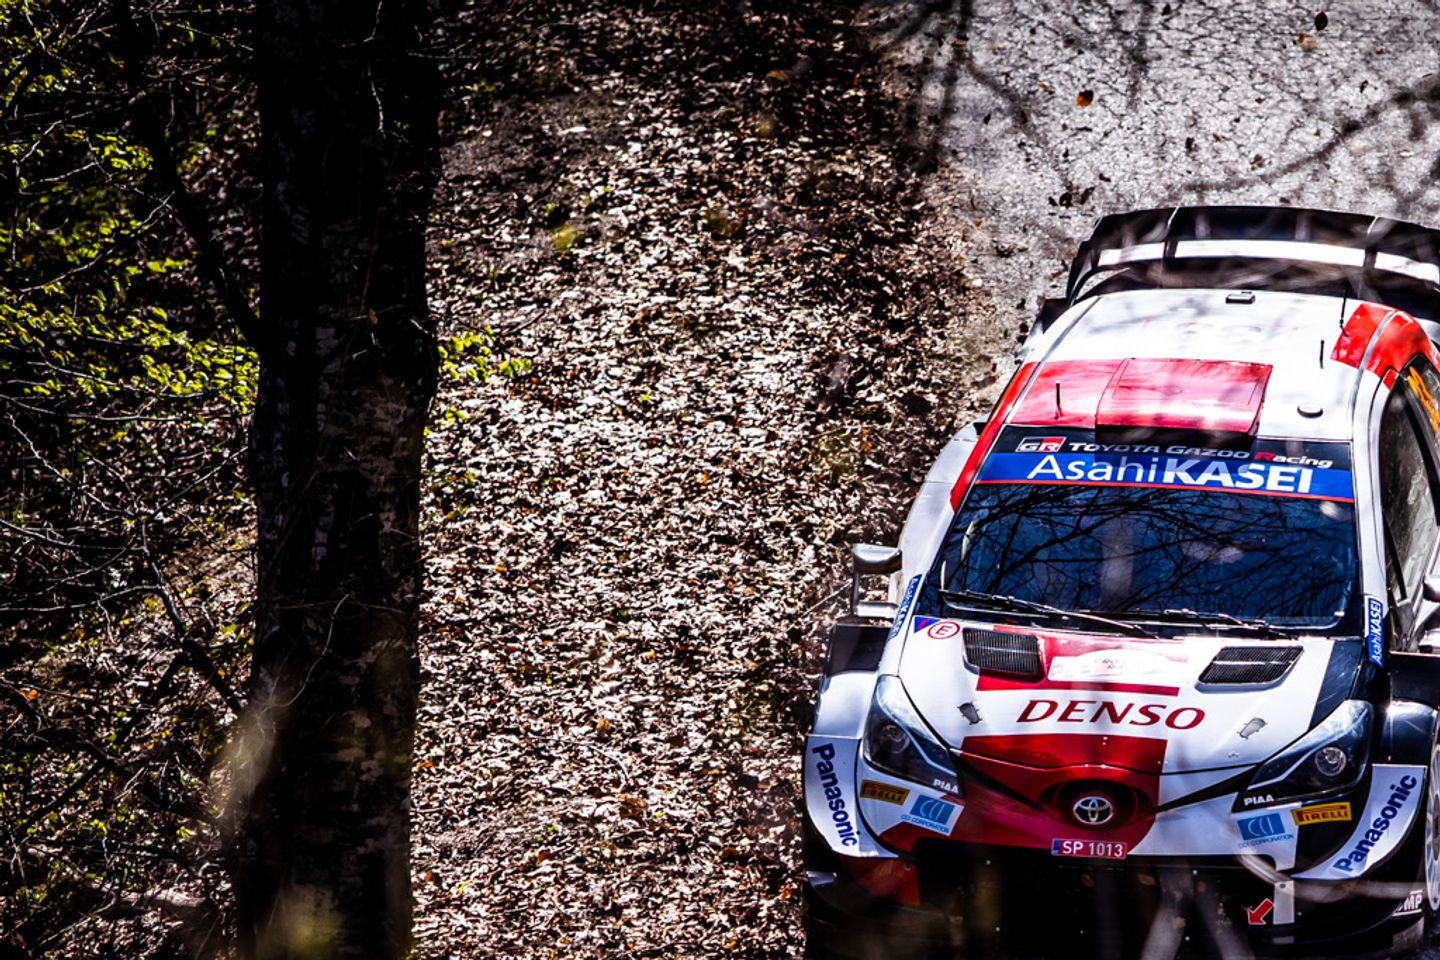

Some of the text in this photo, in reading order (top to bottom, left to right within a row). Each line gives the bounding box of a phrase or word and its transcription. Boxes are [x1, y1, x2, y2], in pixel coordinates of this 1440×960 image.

[1019, 442, 1334, 469] GR TOYOTA GAZOO Racing
[1027, 454, 1314, 494] AsahiKASEI
[1016, 699, 1206, 730] DENSO
[812, 742, 860, 847] Panasonic
[932, 778, 959, 793] PIAA
[1244, 794, 1275, 806] PIAA
[1296, 804, 1348, 822] PIRELLI
[1332, 774, 1417, 872] Panasonic
[1062, 840, 1124, 858] SP 1013
